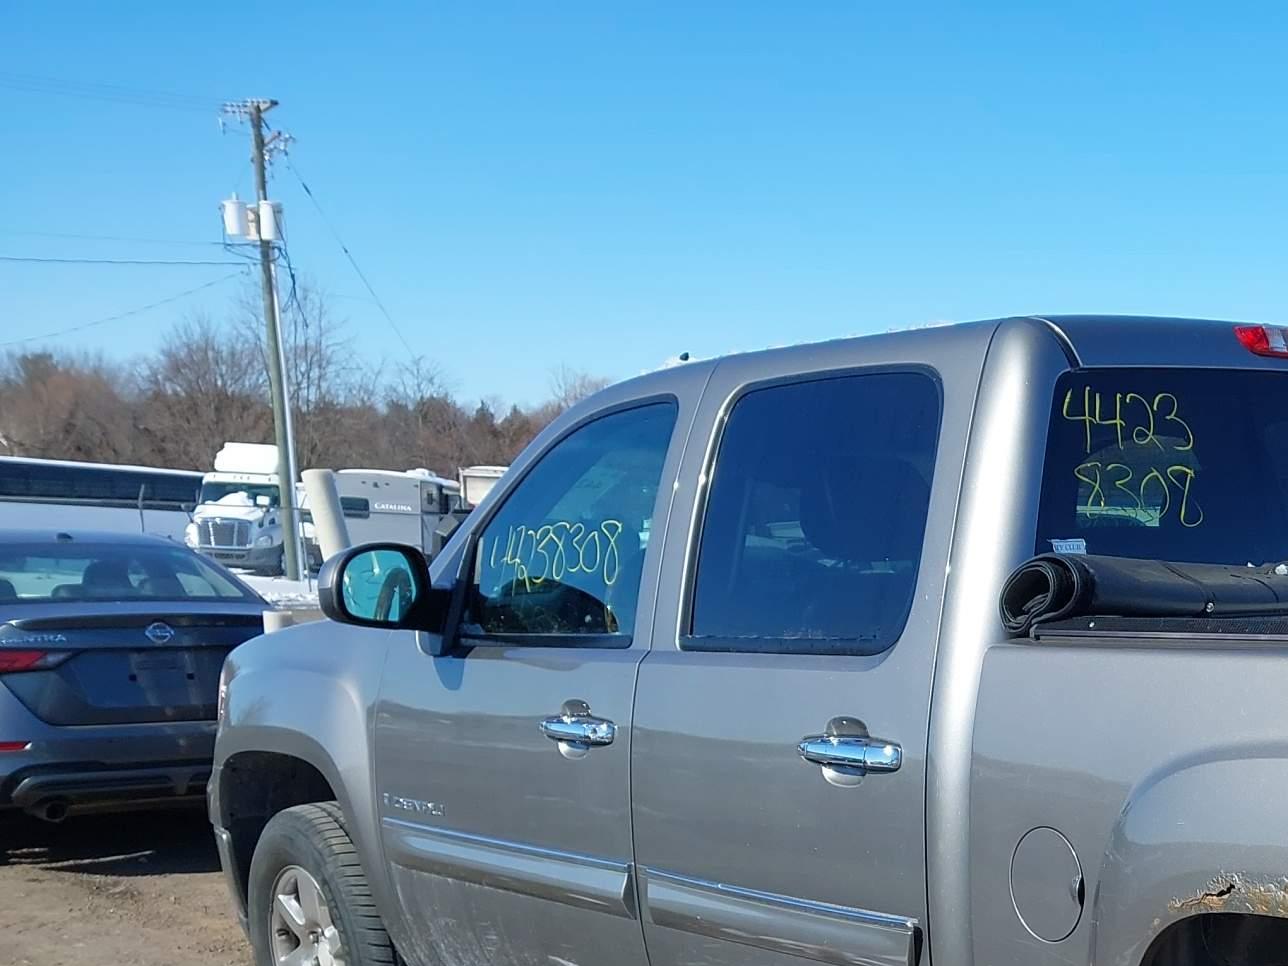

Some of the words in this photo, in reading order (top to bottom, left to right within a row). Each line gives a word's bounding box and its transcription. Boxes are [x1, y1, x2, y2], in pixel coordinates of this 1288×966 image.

[1062, 386, 1194, 454] 4423
[374, 502, 412, 511] CATALINA
[1073, 461, 1204, 528] 8308
